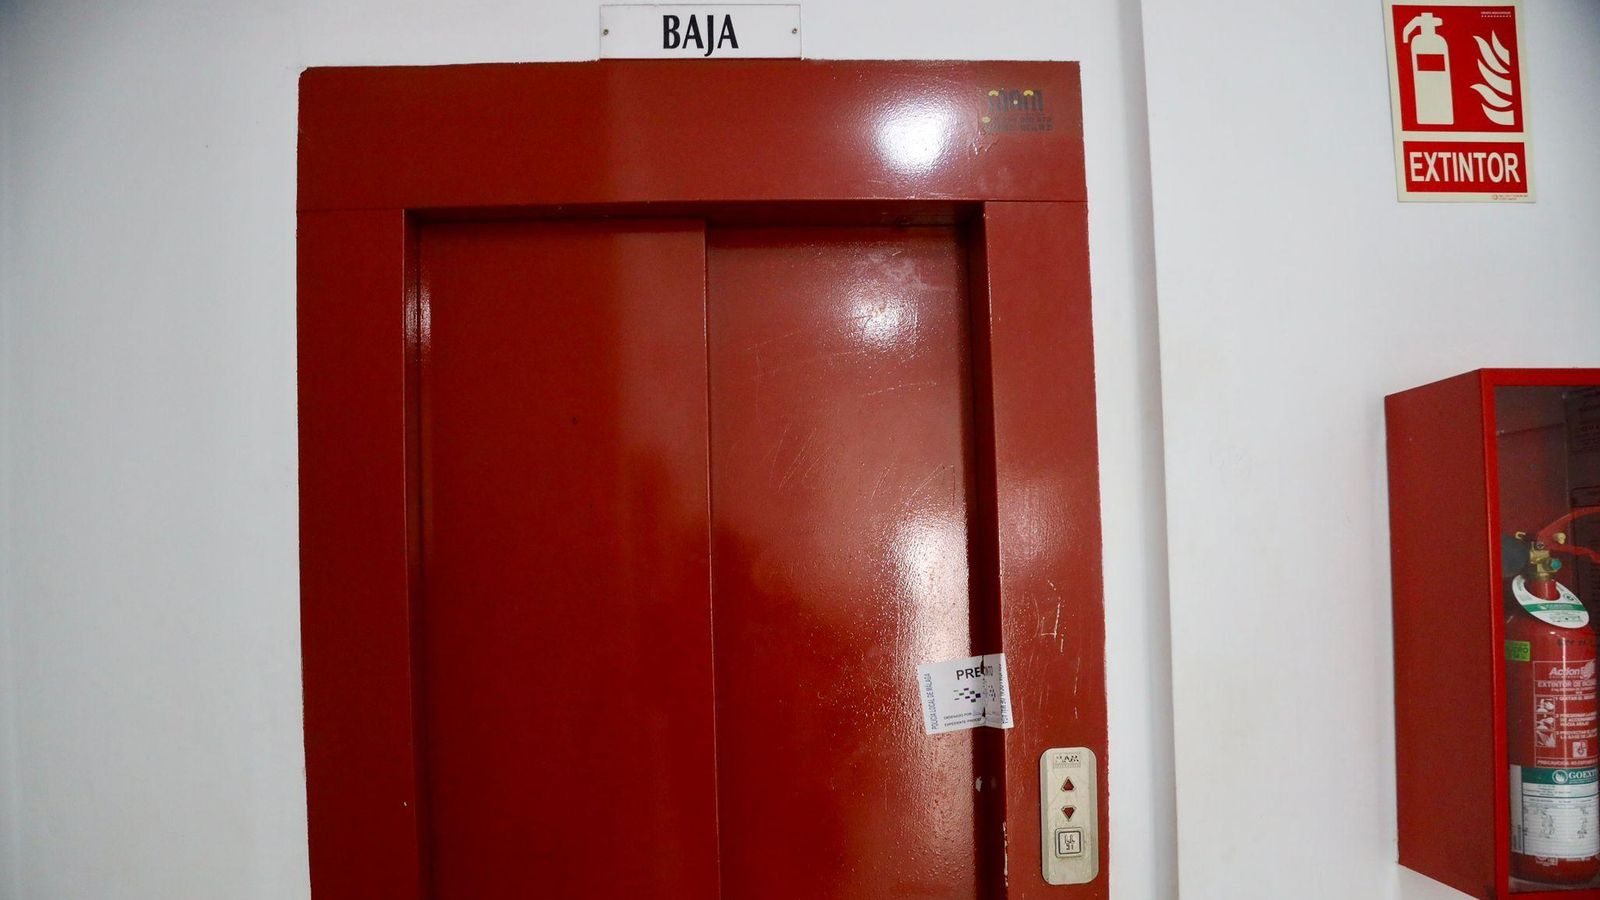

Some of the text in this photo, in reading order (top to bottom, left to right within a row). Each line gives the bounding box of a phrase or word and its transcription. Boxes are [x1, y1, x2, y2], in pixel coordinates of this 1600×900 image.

[663, 14, 739, 57] BAJA
[1409, 151, 1521, 183] EXTINTOR
[926, 698, 936, 713] LOCAL
